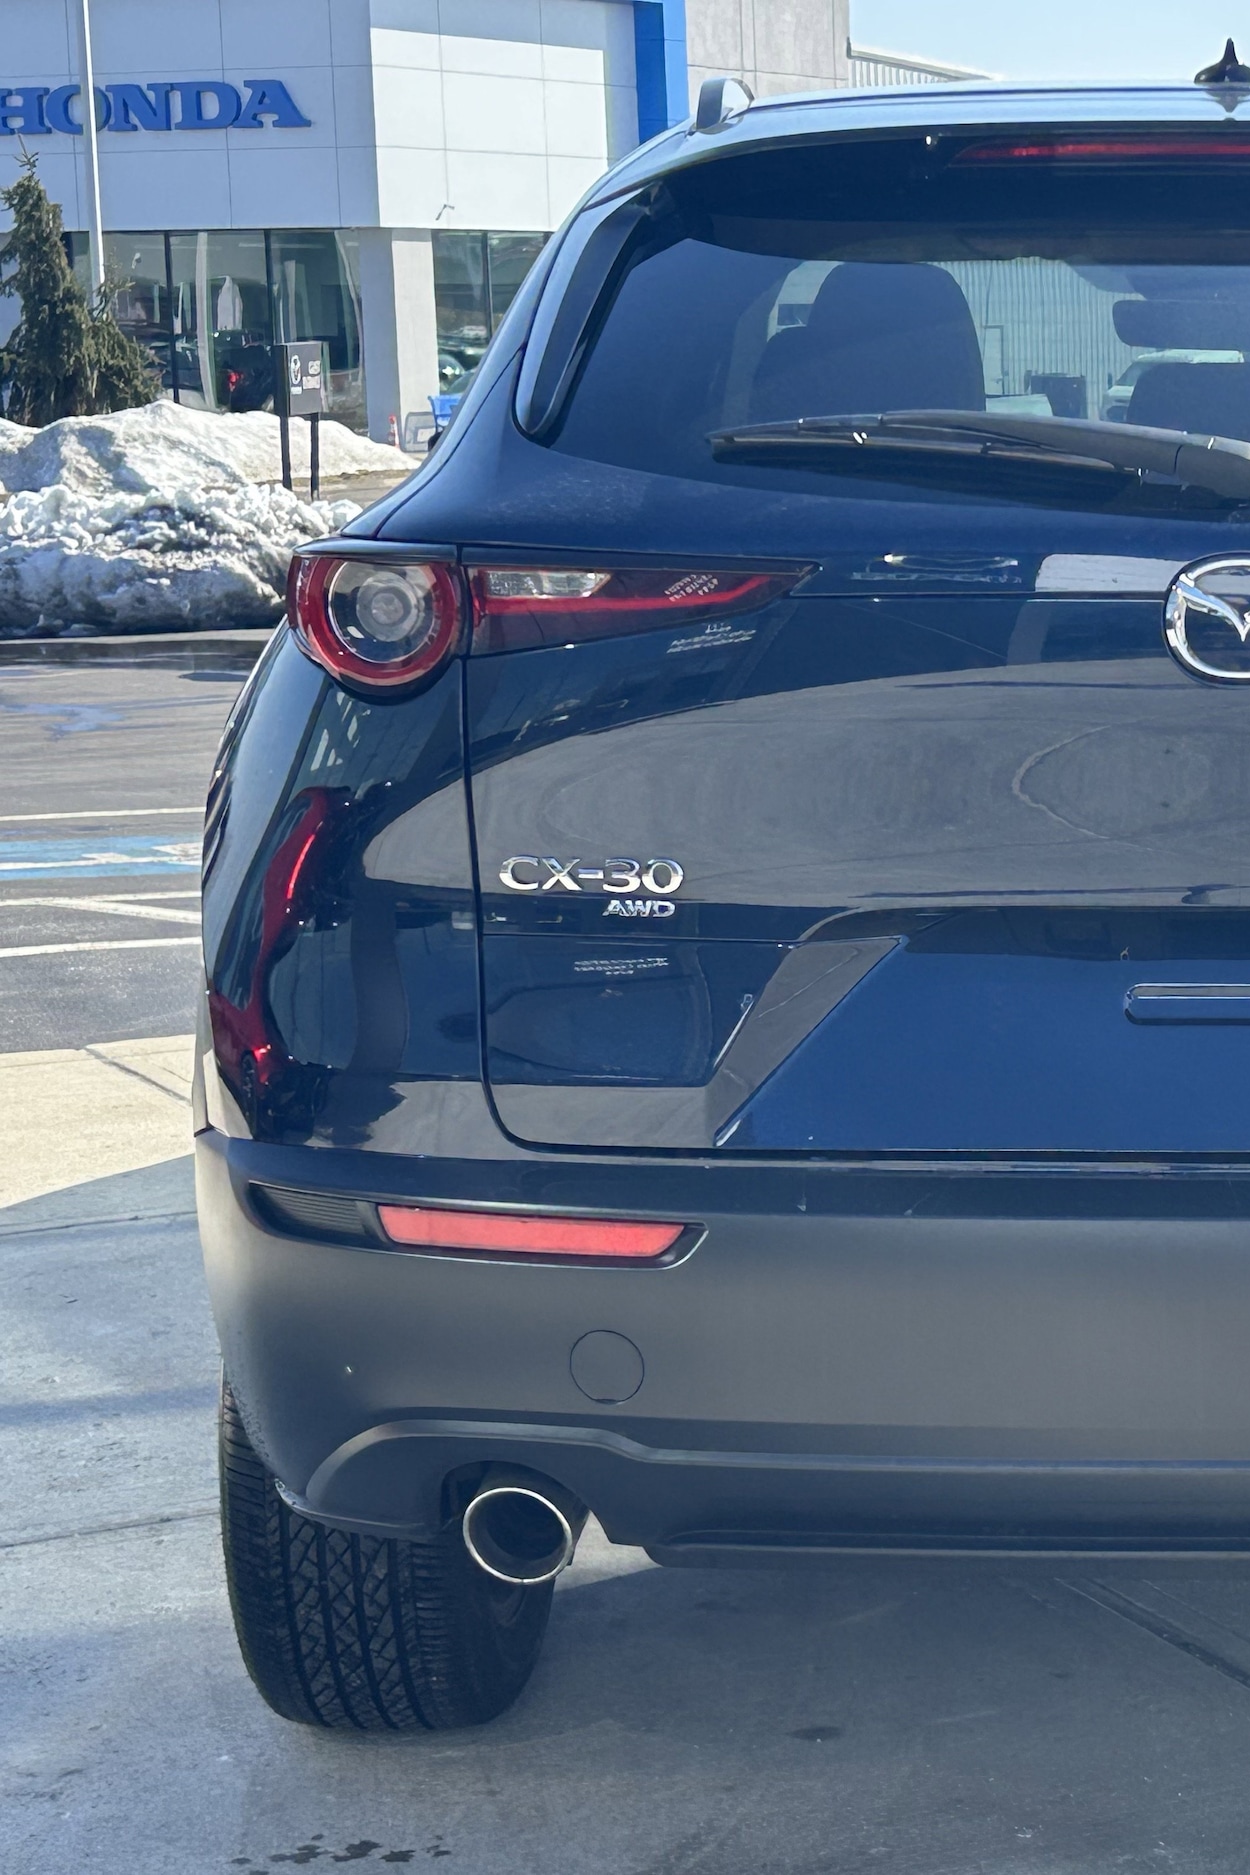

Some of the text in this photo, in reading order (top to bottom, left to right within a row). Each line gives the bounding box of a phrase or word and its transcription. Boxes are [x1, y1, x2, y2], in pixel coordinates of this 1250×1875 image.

[0, 80, 312, 136] HONDA
[499, 855, 684, 894] CX-30
[602, 899, 675, 917] AWD
